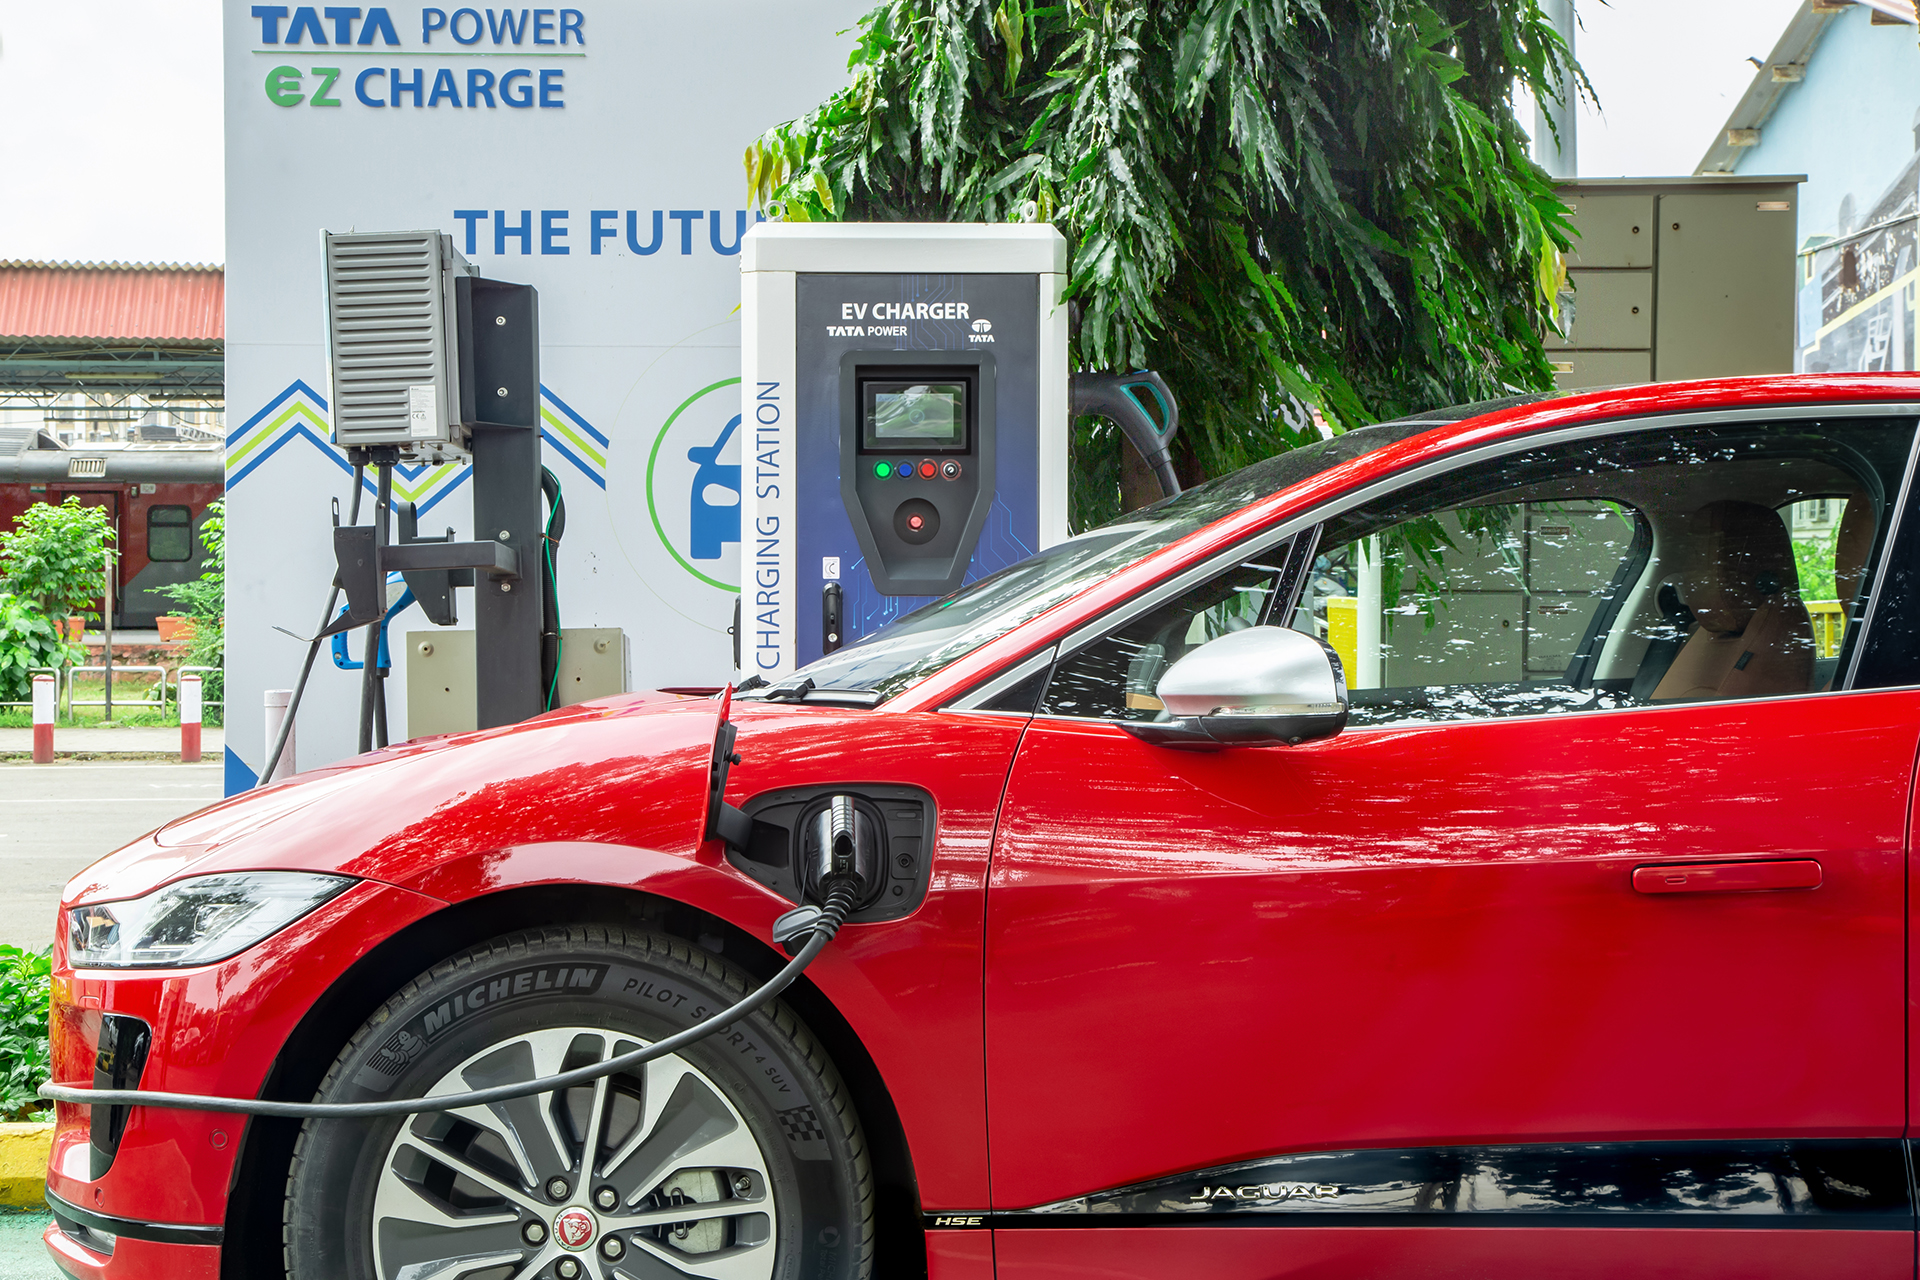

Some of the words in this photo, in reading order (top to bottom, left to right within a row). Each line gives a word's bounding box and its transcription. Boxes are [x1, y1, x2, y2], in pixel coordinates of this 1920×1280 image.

[251, 5, 401, 46] TATA
[421, 7, 586, 46] POWER
[354, 66, 565, 109] CHARGE
[453, 209, 571, 256] THE
[825, 325, 866, 337] TATA
[867, 325, 908, 337] POWER
[841, 302, 869, 320] EV
[871, 302, 970, 320] CHARGER
[967, 334, 995, 343] TATA
[756, 381, 780, 499] STATION
[756, 515, 780, 670] CHARGING
[423, 967, 599, 1036] MICHELIN
[622, 977, 688, 1009] PILOT
[754, 1054, 766, 1065] 4
[764, 1066, 791, 1095] SUV
[1189, 1185, 1340, 1200] JAGUAR
[934, 1216, 984, 1226] HSE
